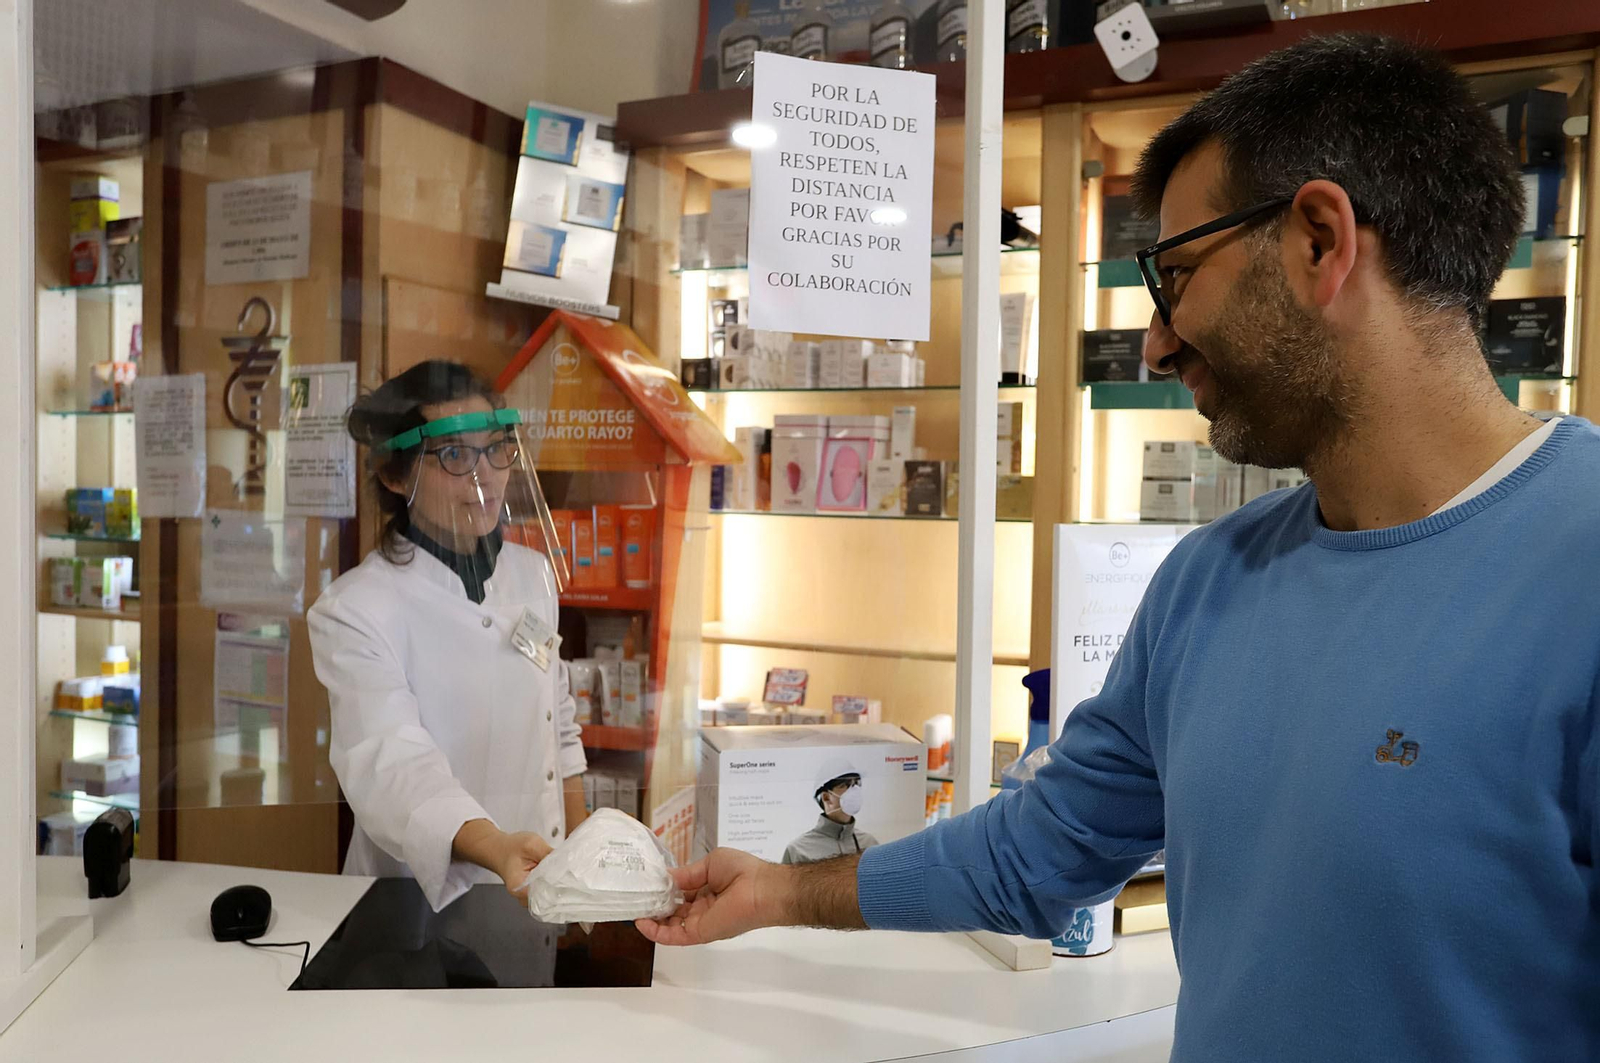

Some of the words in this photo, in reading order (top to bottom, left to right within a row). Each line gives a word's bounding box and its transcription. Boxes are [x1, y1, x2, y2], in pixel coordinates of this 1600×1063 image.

[811, 82, 849, 102] POR
[855, 87, 881, 105] LA
[772, 101, 887, 130] SEGURIDAD
[893, 115, 918, 134] DE
[809, 130, 880, 156] TODOS,
[779, 151, 878, 177] RESPETEN
[883, 162, 909, 180] LA
[791, 176, 896, 203] DISTANCIA
[790, 201, 828, 221] POR
[834, 206, 896, 227] FAV
[782, 226, 863, 249] GRACIAS
[868, 234, 902, 252] POR
[831, 253, 854, 270] SU
[767, 271, 912, 297] COLABORACIÓN
[548, 296, 601, 314] BOOSTERS
[551, 408, 566, 424] TE
[568, 408, 635, 424] PROTEGE
[527, 425, 585, 441] CUARTO
[587, 425, 634, 441] RAYO?
[1073, 634, 1112, 647] FELIZ
[1082, 650, 1101, 663] LA
[729, 760, 758, 770] SuperOne
[759, 760, 776, 768] series
